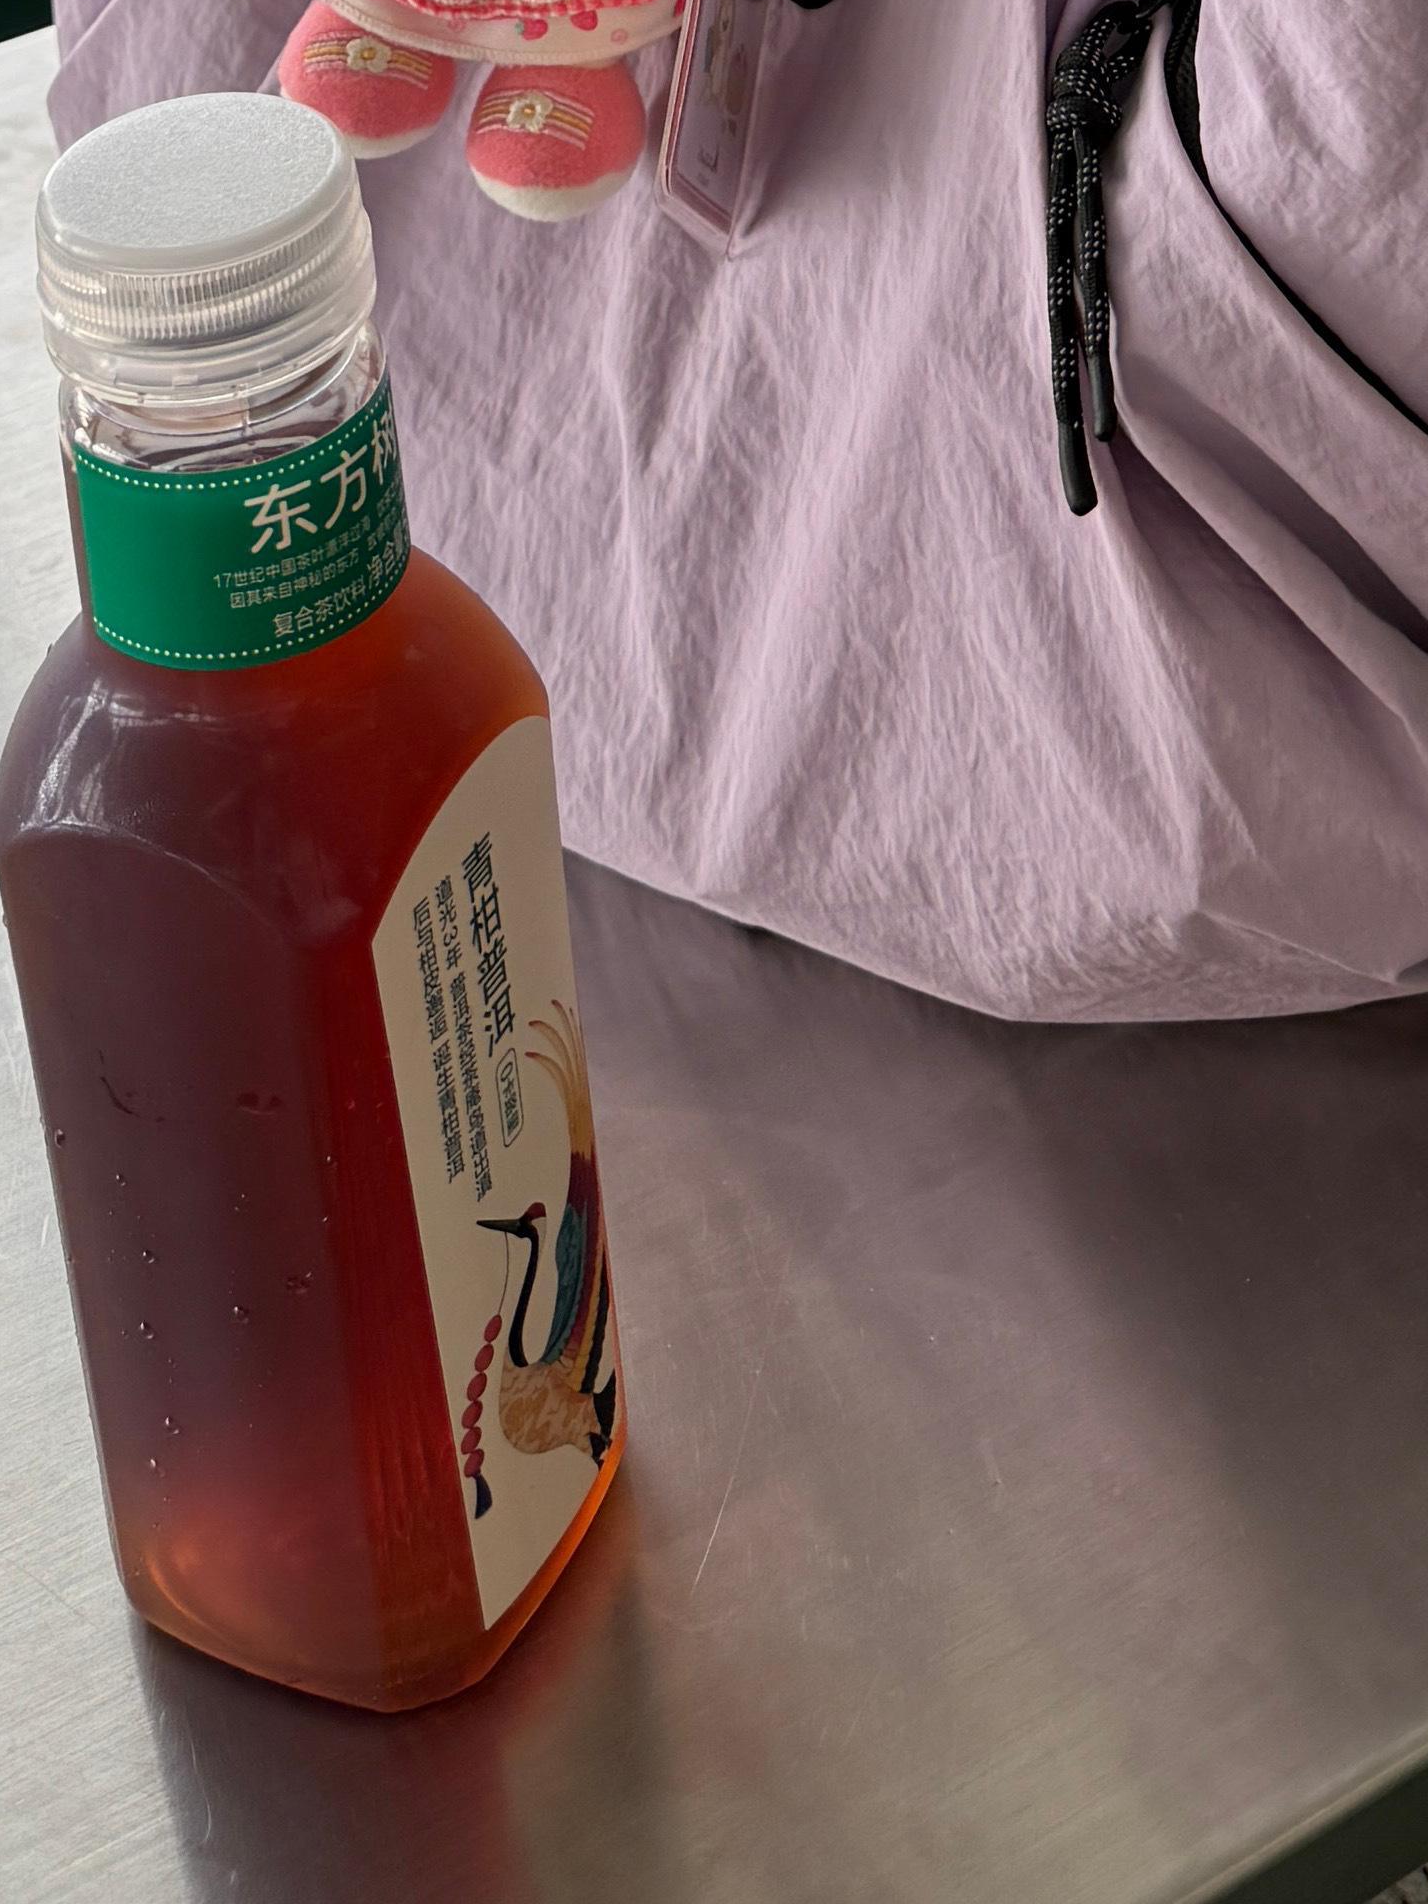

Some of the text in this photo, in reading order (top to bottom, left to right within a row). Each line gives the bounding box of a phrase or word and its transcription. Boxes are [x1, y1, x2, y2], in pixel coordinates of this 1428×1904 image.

[230, 548, 359, 609] 因其来自神秘的东方
[273, 575, 365, 638] 复合茶饮料
[461, 831, 515, 1058] 青柑普洱
